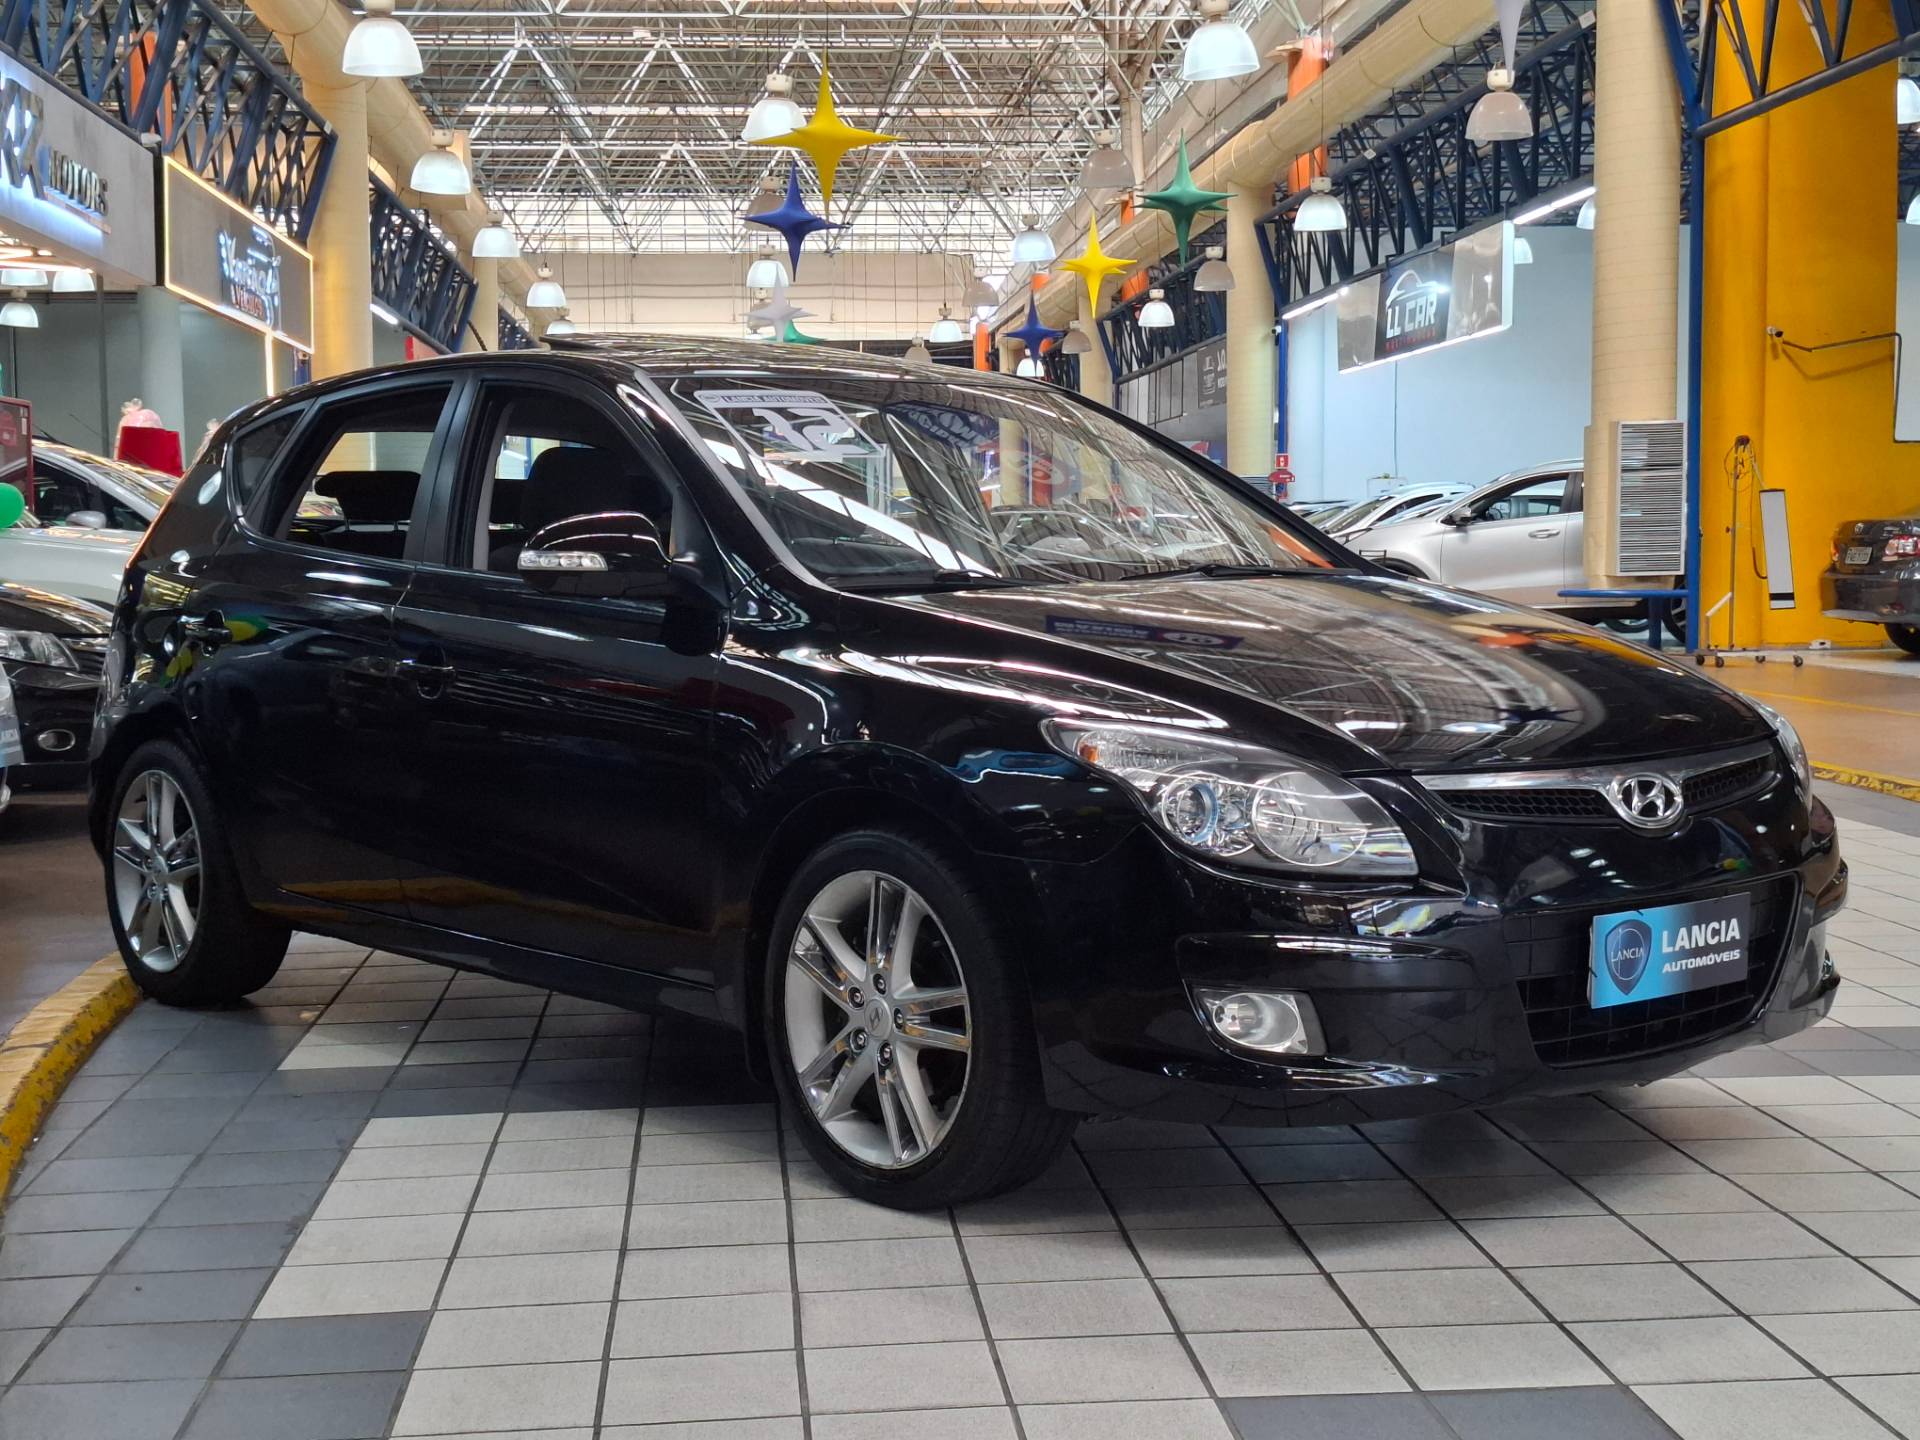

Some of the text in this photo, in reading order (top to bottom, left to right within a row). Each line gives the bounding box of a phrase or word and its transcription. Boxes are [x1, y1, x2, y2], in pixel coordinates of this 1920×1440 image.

[50, 150, 109, 216] MOTORS
[1405, 292, 1438, 332] CAR
[752, 407, 871, 455] 12
[1611, 947, 1645, 962] LANCIA
[1662, 918, 1741, 954] LANCIA
[1662, 949, 1741, 974] AUTOMÓVEIS
